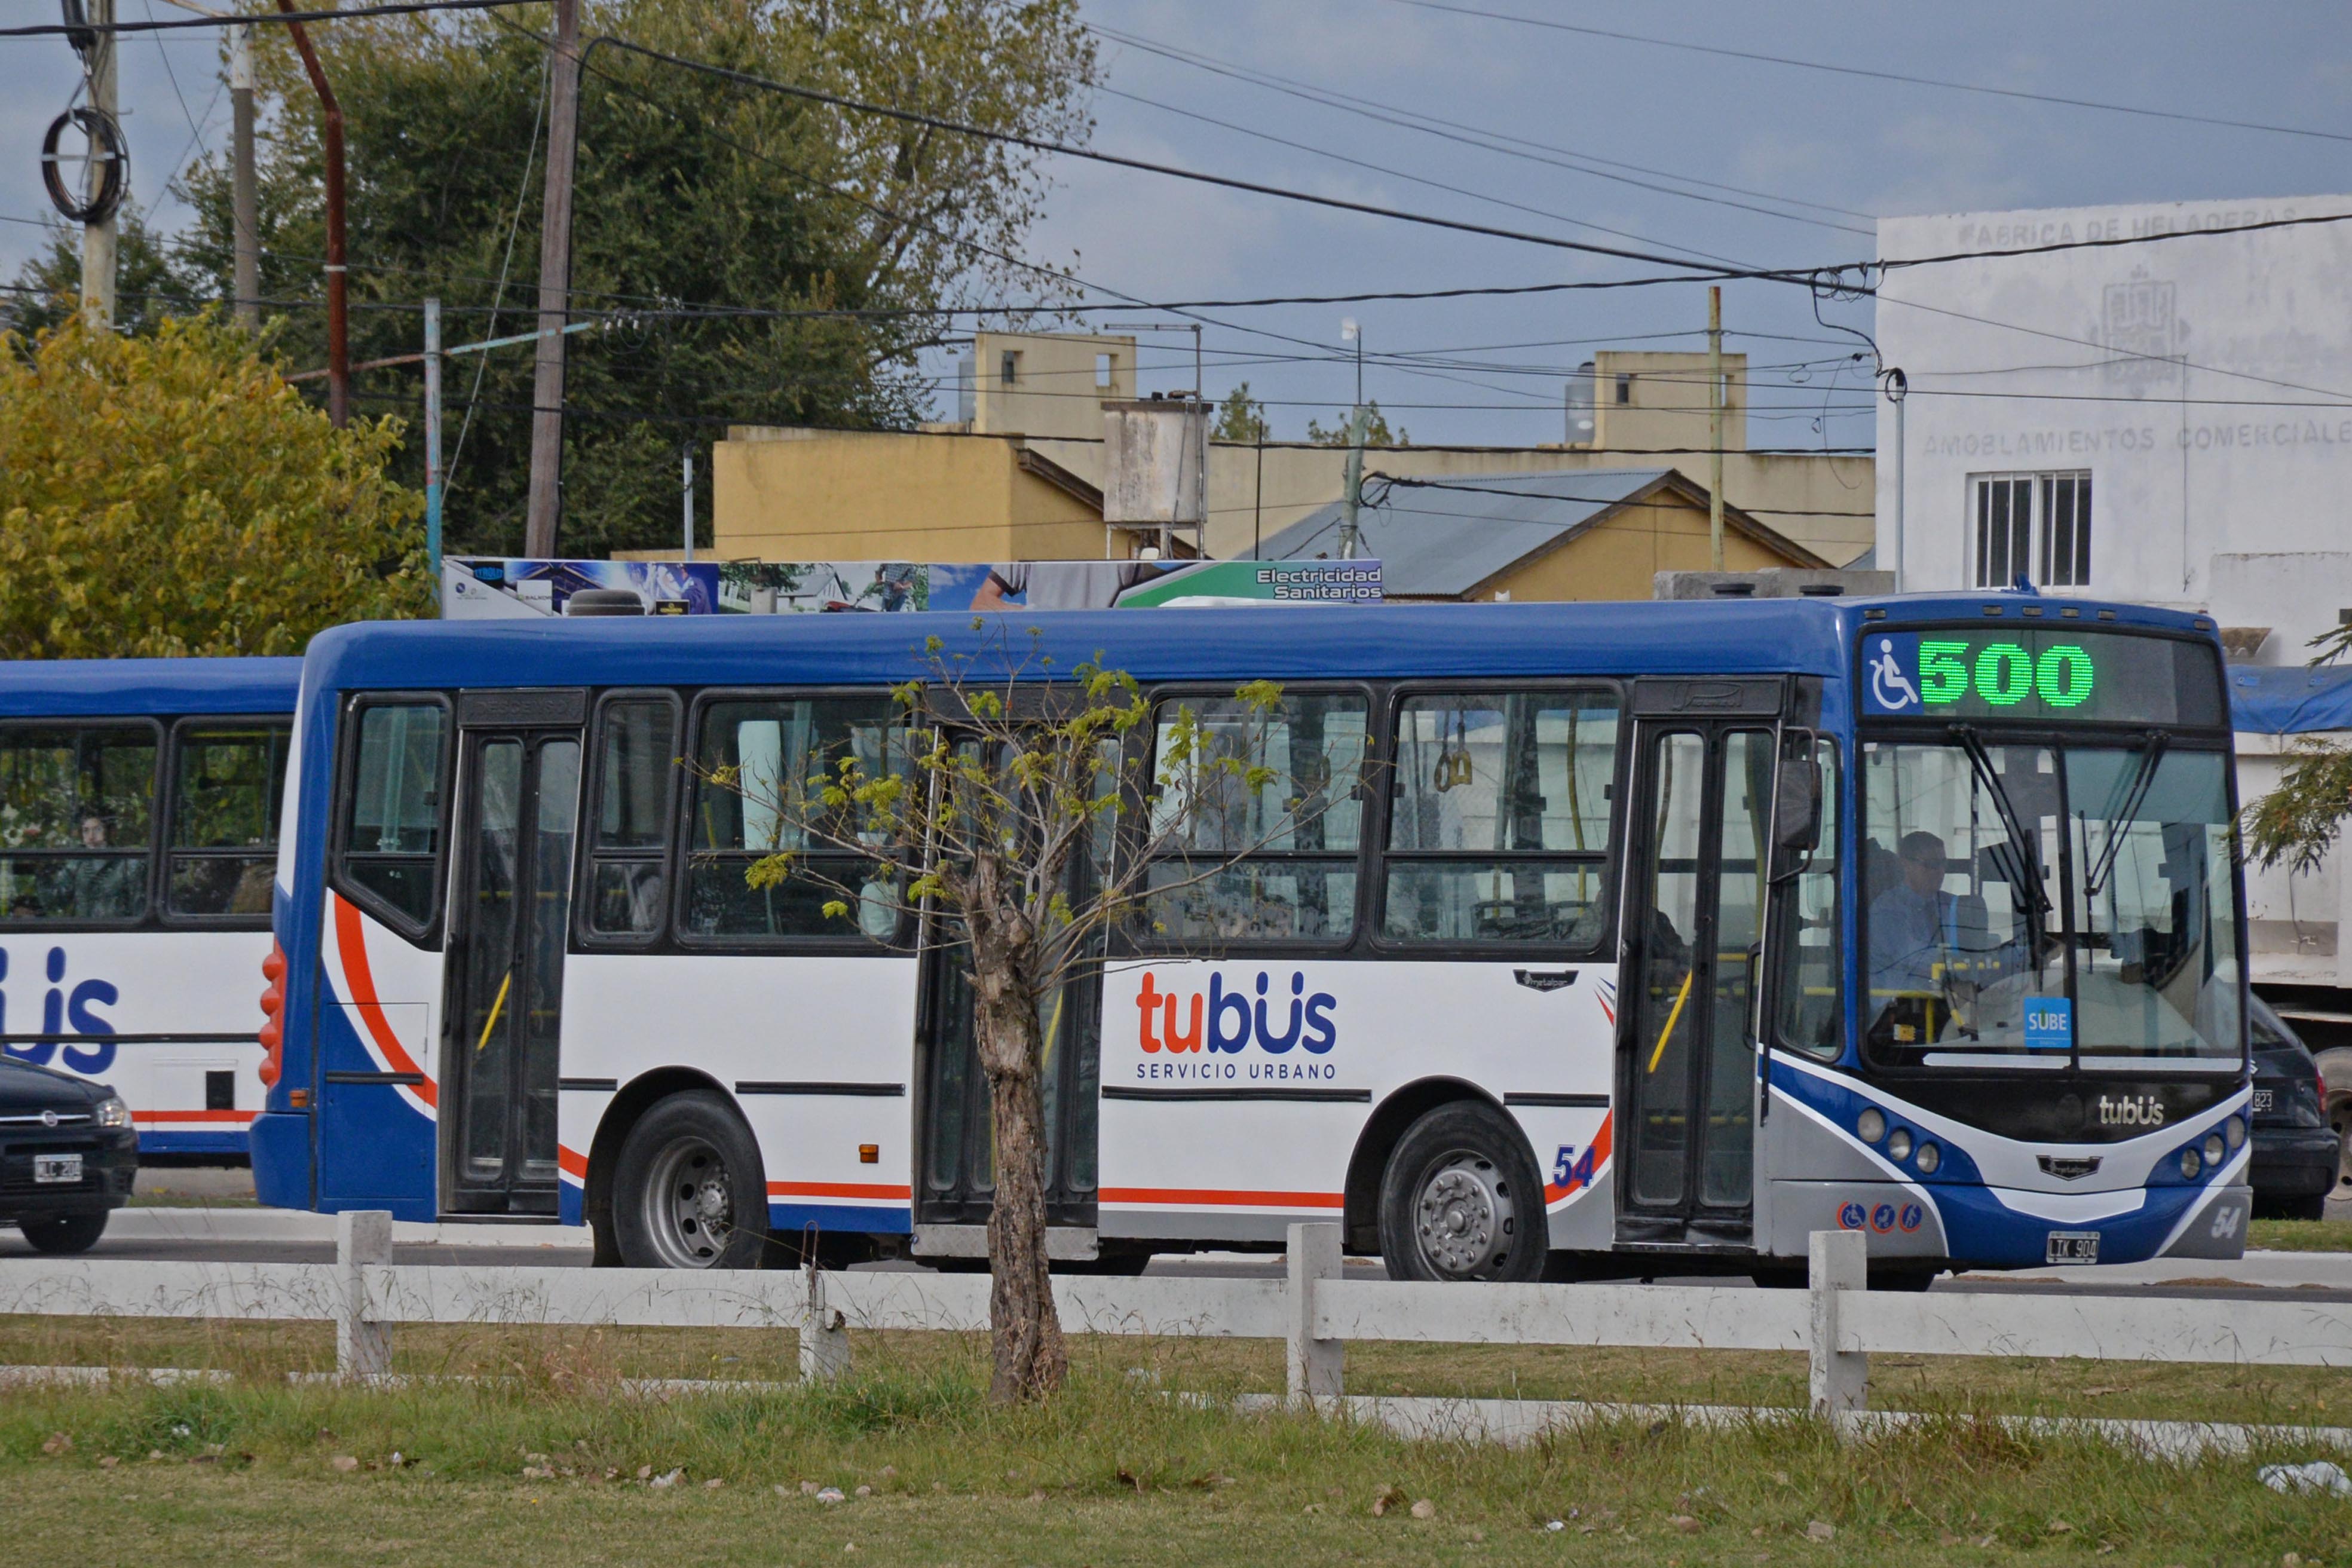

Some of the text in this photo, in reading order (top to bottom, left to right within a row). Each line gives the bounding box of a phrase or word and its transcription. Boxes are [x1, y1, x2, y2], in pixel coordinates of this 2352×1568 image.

[2086, 218, 2120, 243] DE
[1923, 428, 2155, 457] AMOBLAMIENTOS
[1257, 566, 1382, 583] Electricidad
[1273, 584, 1382, 599] Sanitarios
[1919, 641, 2093, 707] 500
[1136, 971, 1337, 1055] tubüs
[2029, 1012, 2067, 1031] SUBE
[1137, 1063, 1336, 1079] SERVICIO URBANO
[2255, 1092, 2272, 1107] 823
[1552, 1144, 1596, 1189] 54
[2211, 1206, 2242, 1239] 54
[2049, 1239, 2097, 1257] LIK 904
